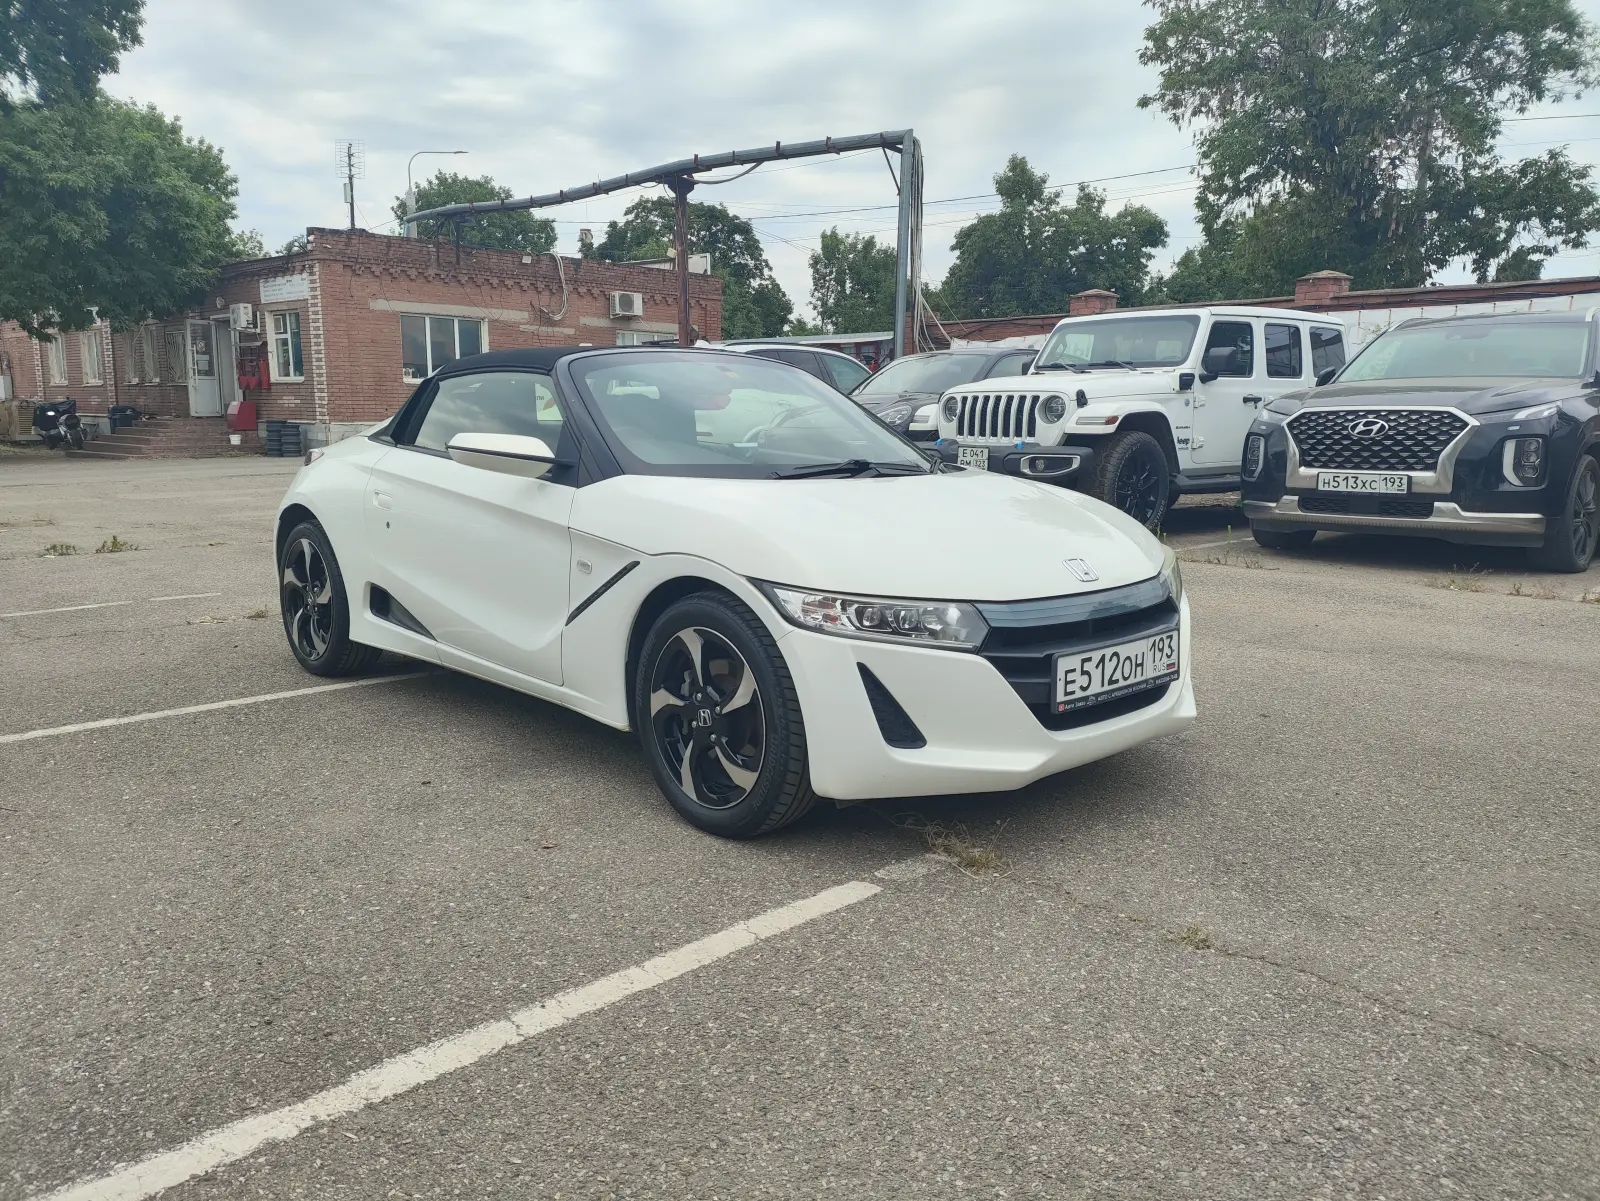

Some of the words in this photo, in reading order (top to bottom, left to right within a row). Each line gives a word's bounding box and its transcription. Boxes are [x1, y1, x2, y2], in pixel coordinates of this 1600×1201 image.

[1177, 436, 1190, 446] Jeep
[970, 449, 983, 458] 041
[1382, 476, 1404, 488] 193
[1149, 633, 1175, 665] 193
[1153, 661, 1167, 674] RUS
